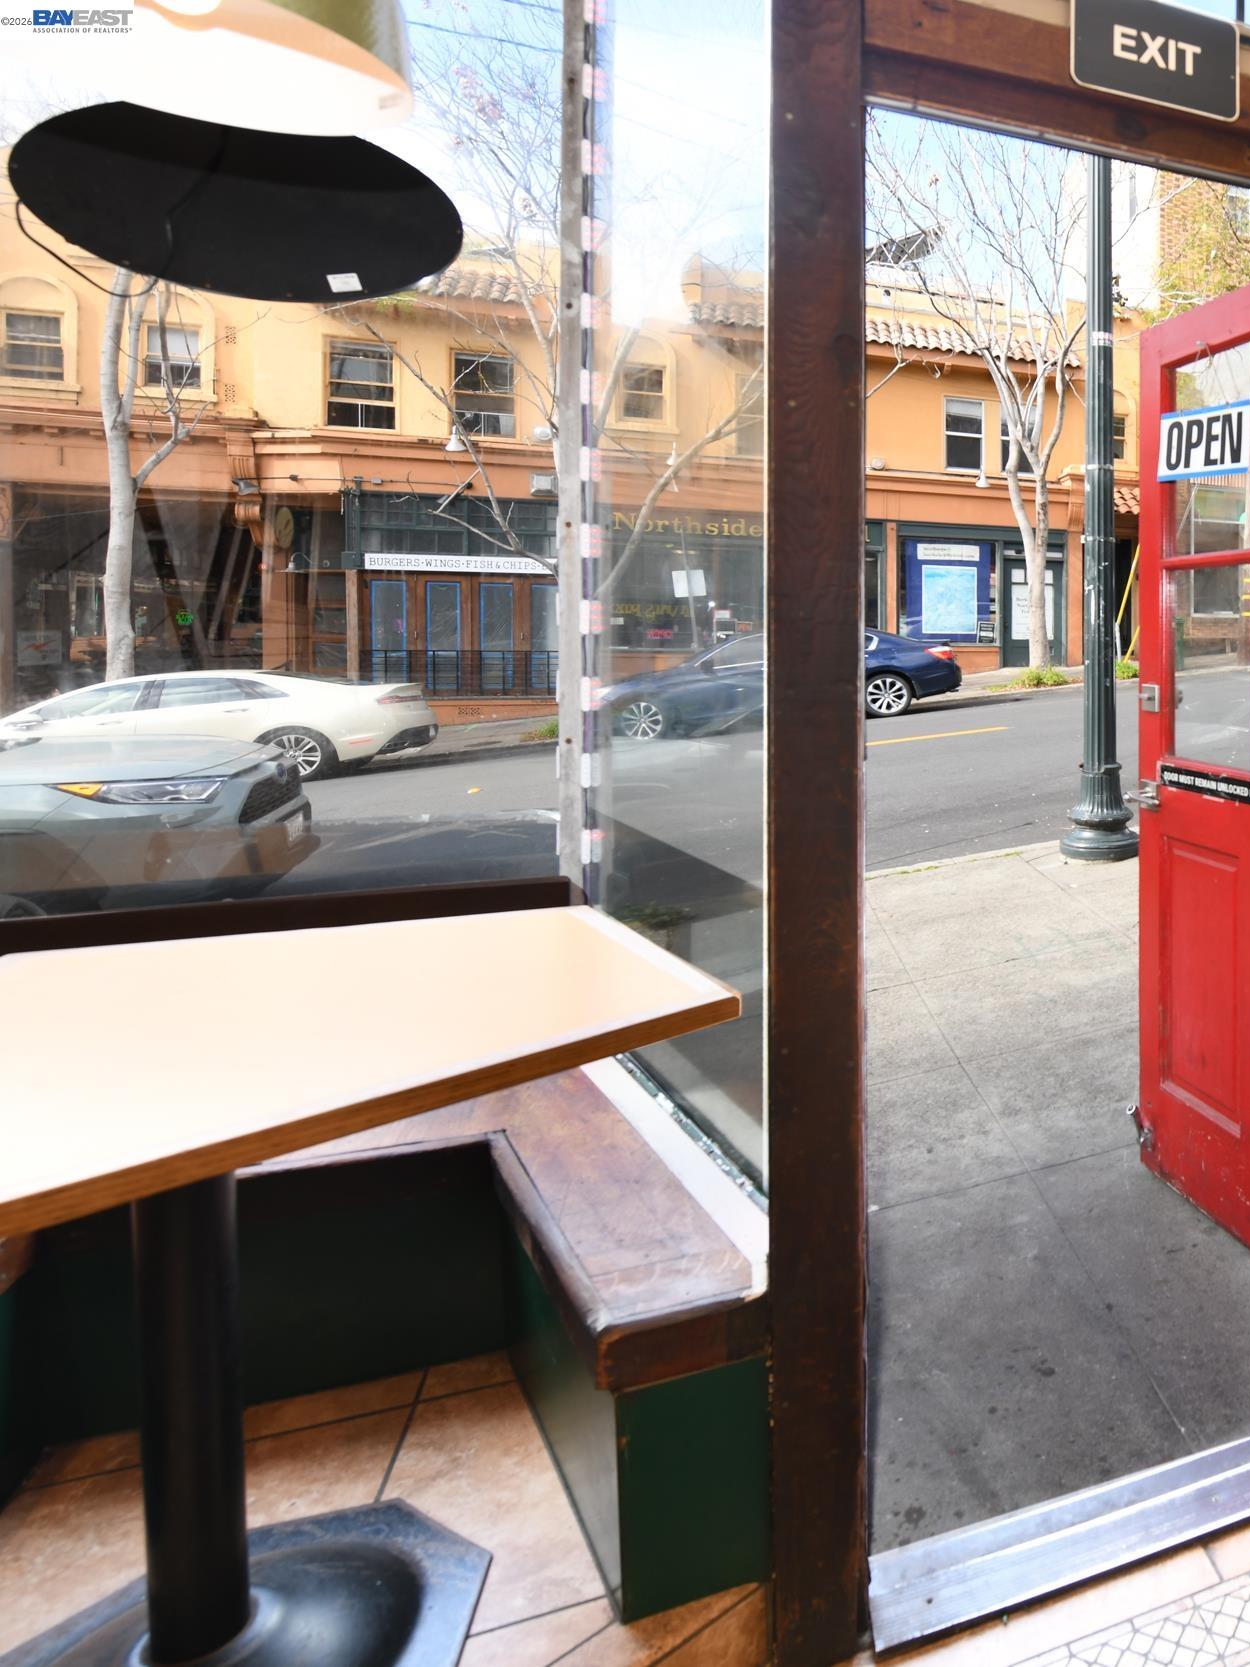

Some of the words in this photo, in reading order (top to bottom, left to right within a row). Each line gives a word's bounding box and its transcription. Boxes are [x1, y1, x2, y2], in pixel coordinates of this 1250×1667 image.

[1113, 24, 1202, 76] EXIT
[1165, 411, 1243, 471] OPEN
[369, 557, 420, 567] BURGERS
[425, 558, 461, 569] WINGS
[466, 560, 493, 569] FISH
[503, 561, 537, 570] CHIPS
[1178, 774, 1195, 786] MUST
[1195, 777, 1217, 791] REMAIN
[1217, 782, 1249, 797] UNLOCKED
